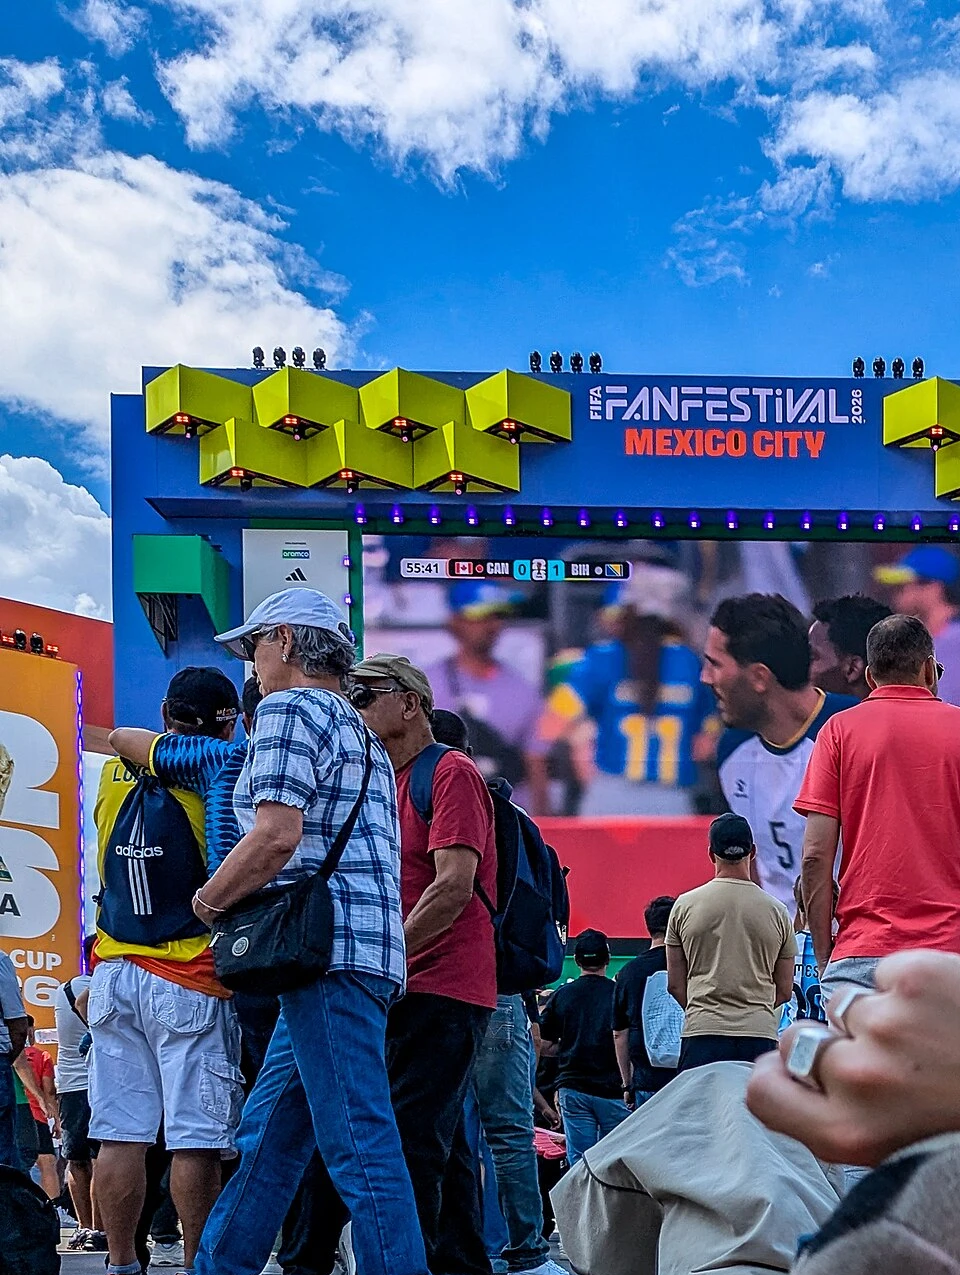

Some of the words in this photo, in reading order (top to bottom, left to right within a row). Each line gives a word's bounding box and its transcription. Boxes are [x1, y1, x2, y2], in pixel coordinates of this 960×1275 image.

[590, 385, 602, 420] FIFA
[851, 389, 863, 424] 2026
[625, 429, 747, 457] MEXICO
[753, 430, 825, 458] CITY
[406, 562, 440, 574] 55:41
[486, 562, 510, 575] CAN
[518, 563, 527, 576] 0
[553, 564, 559, 577] 1
[571, 563, 590, 576] BIH
[619, 714, 684, 785] 11
[115, 844, 164, 859] adidas
[768, 821, 794, 870] 5
[9, 948, 62, 971] CUP
